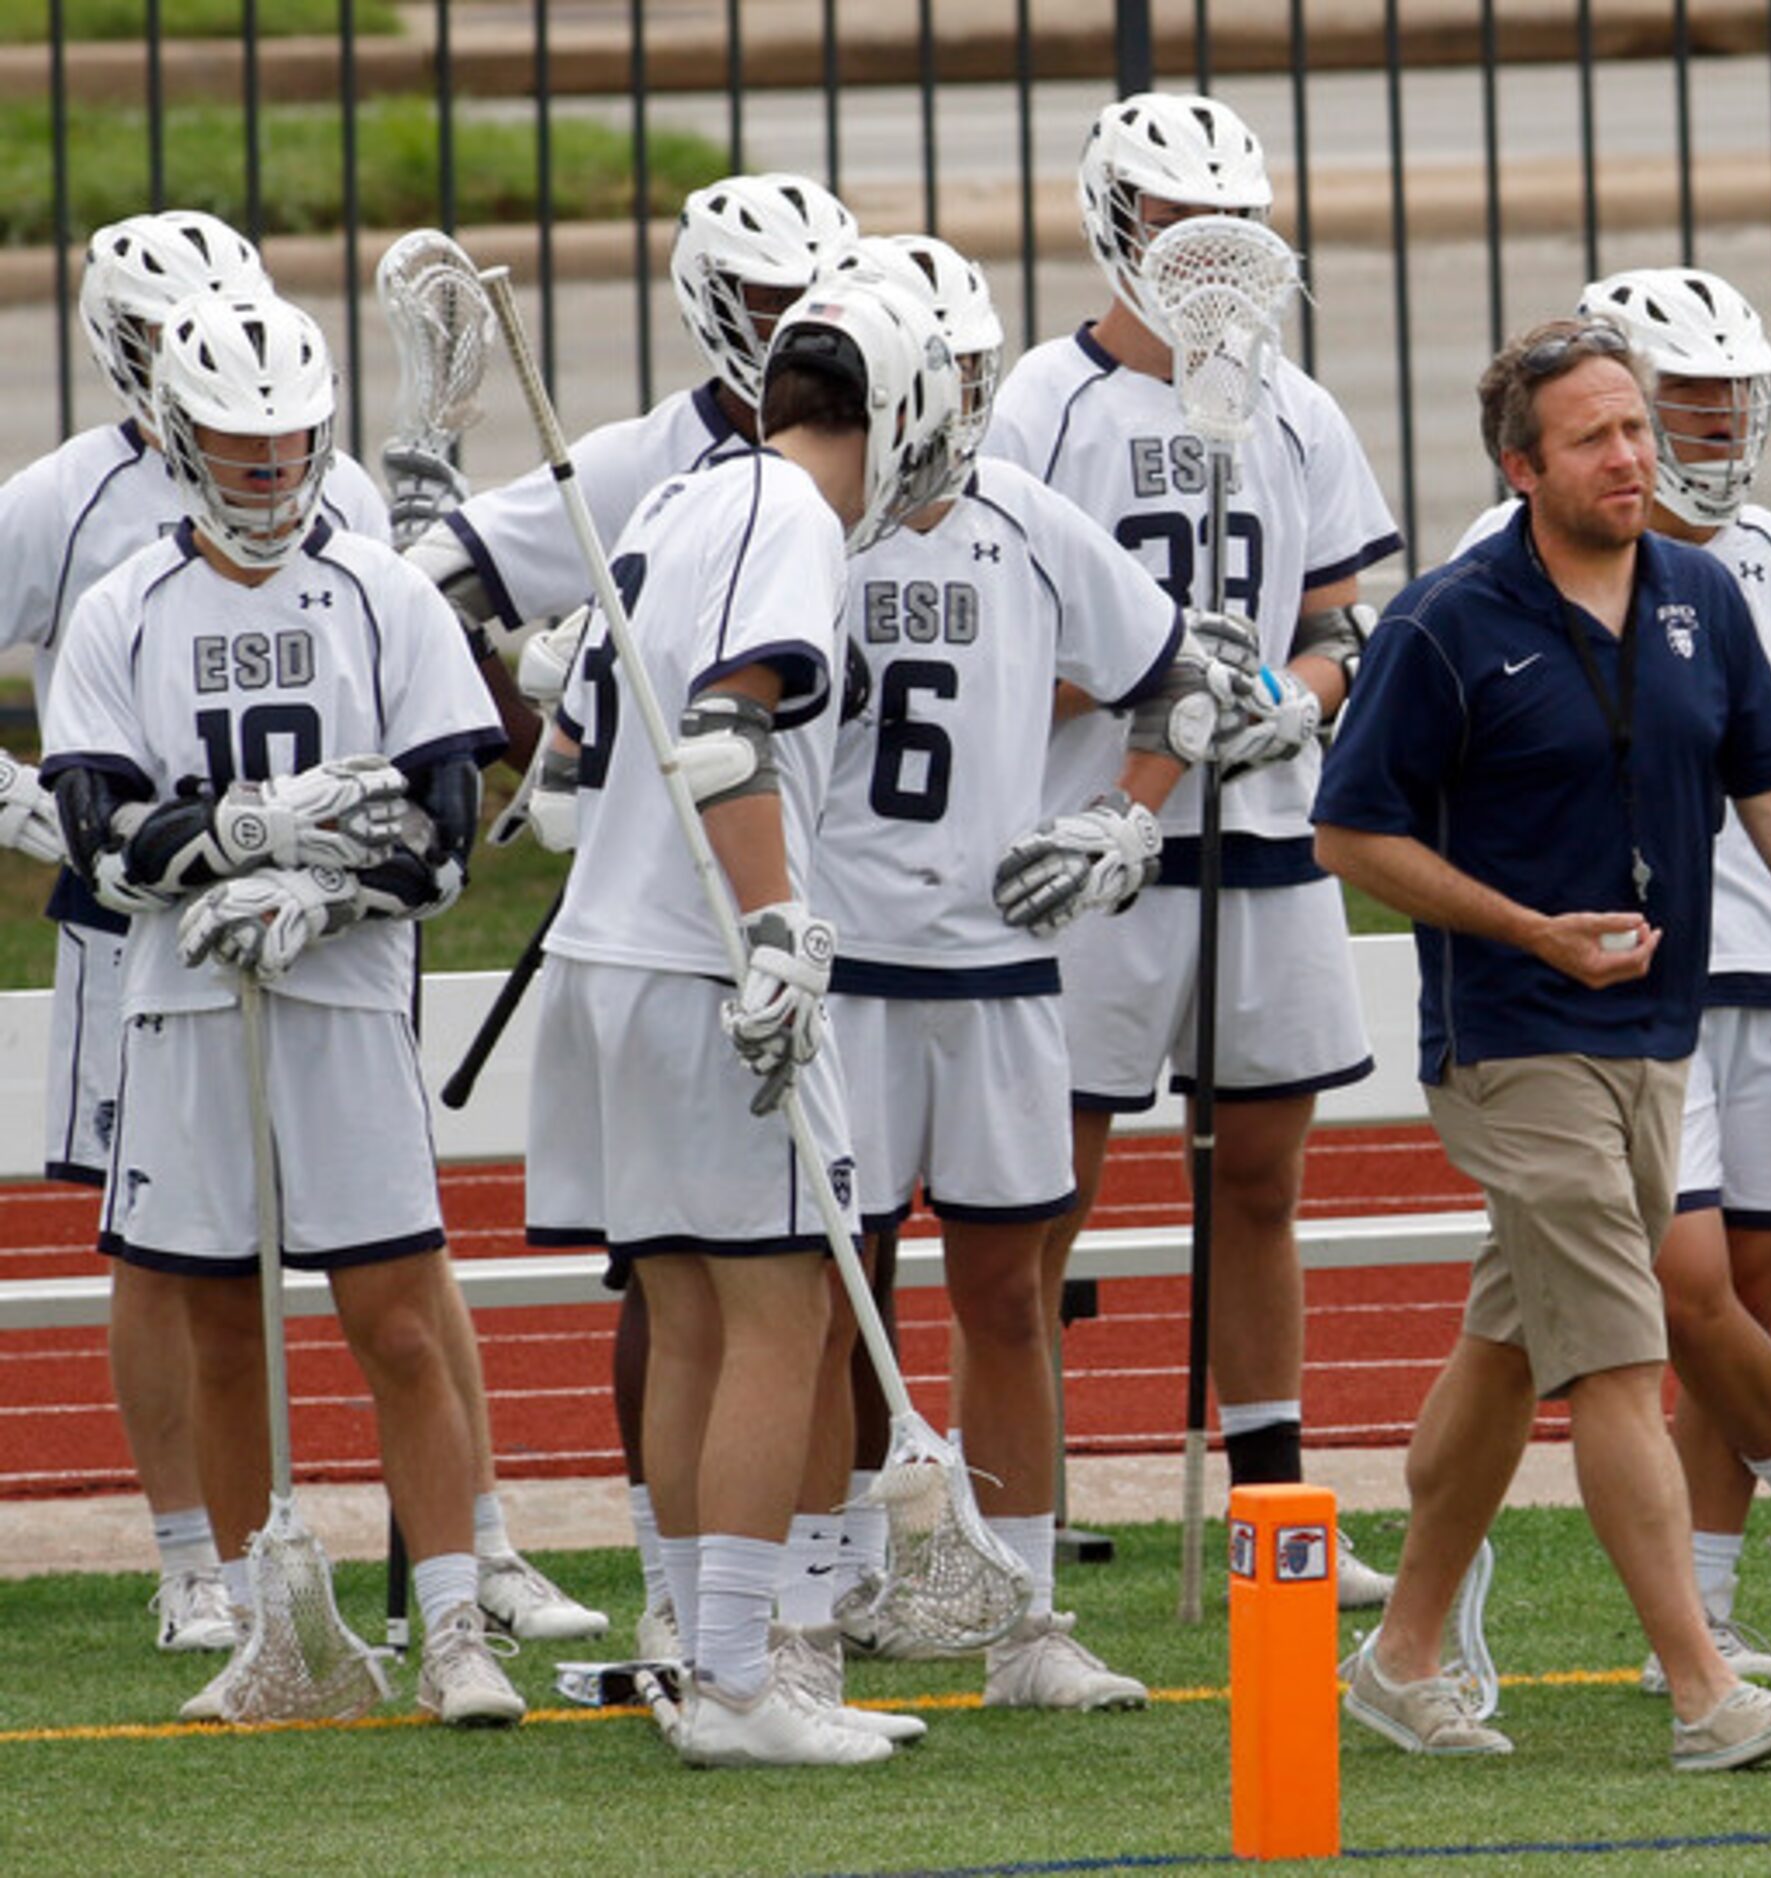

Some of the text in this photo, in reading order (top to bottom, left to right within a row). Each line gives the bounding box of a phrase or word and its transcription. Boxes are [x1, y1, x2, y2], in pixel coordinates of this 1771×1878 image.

[865, 580, 979, 645] ESD
[193, 629, 315, 694] ESD
[869, 659, 958, 824] 6
